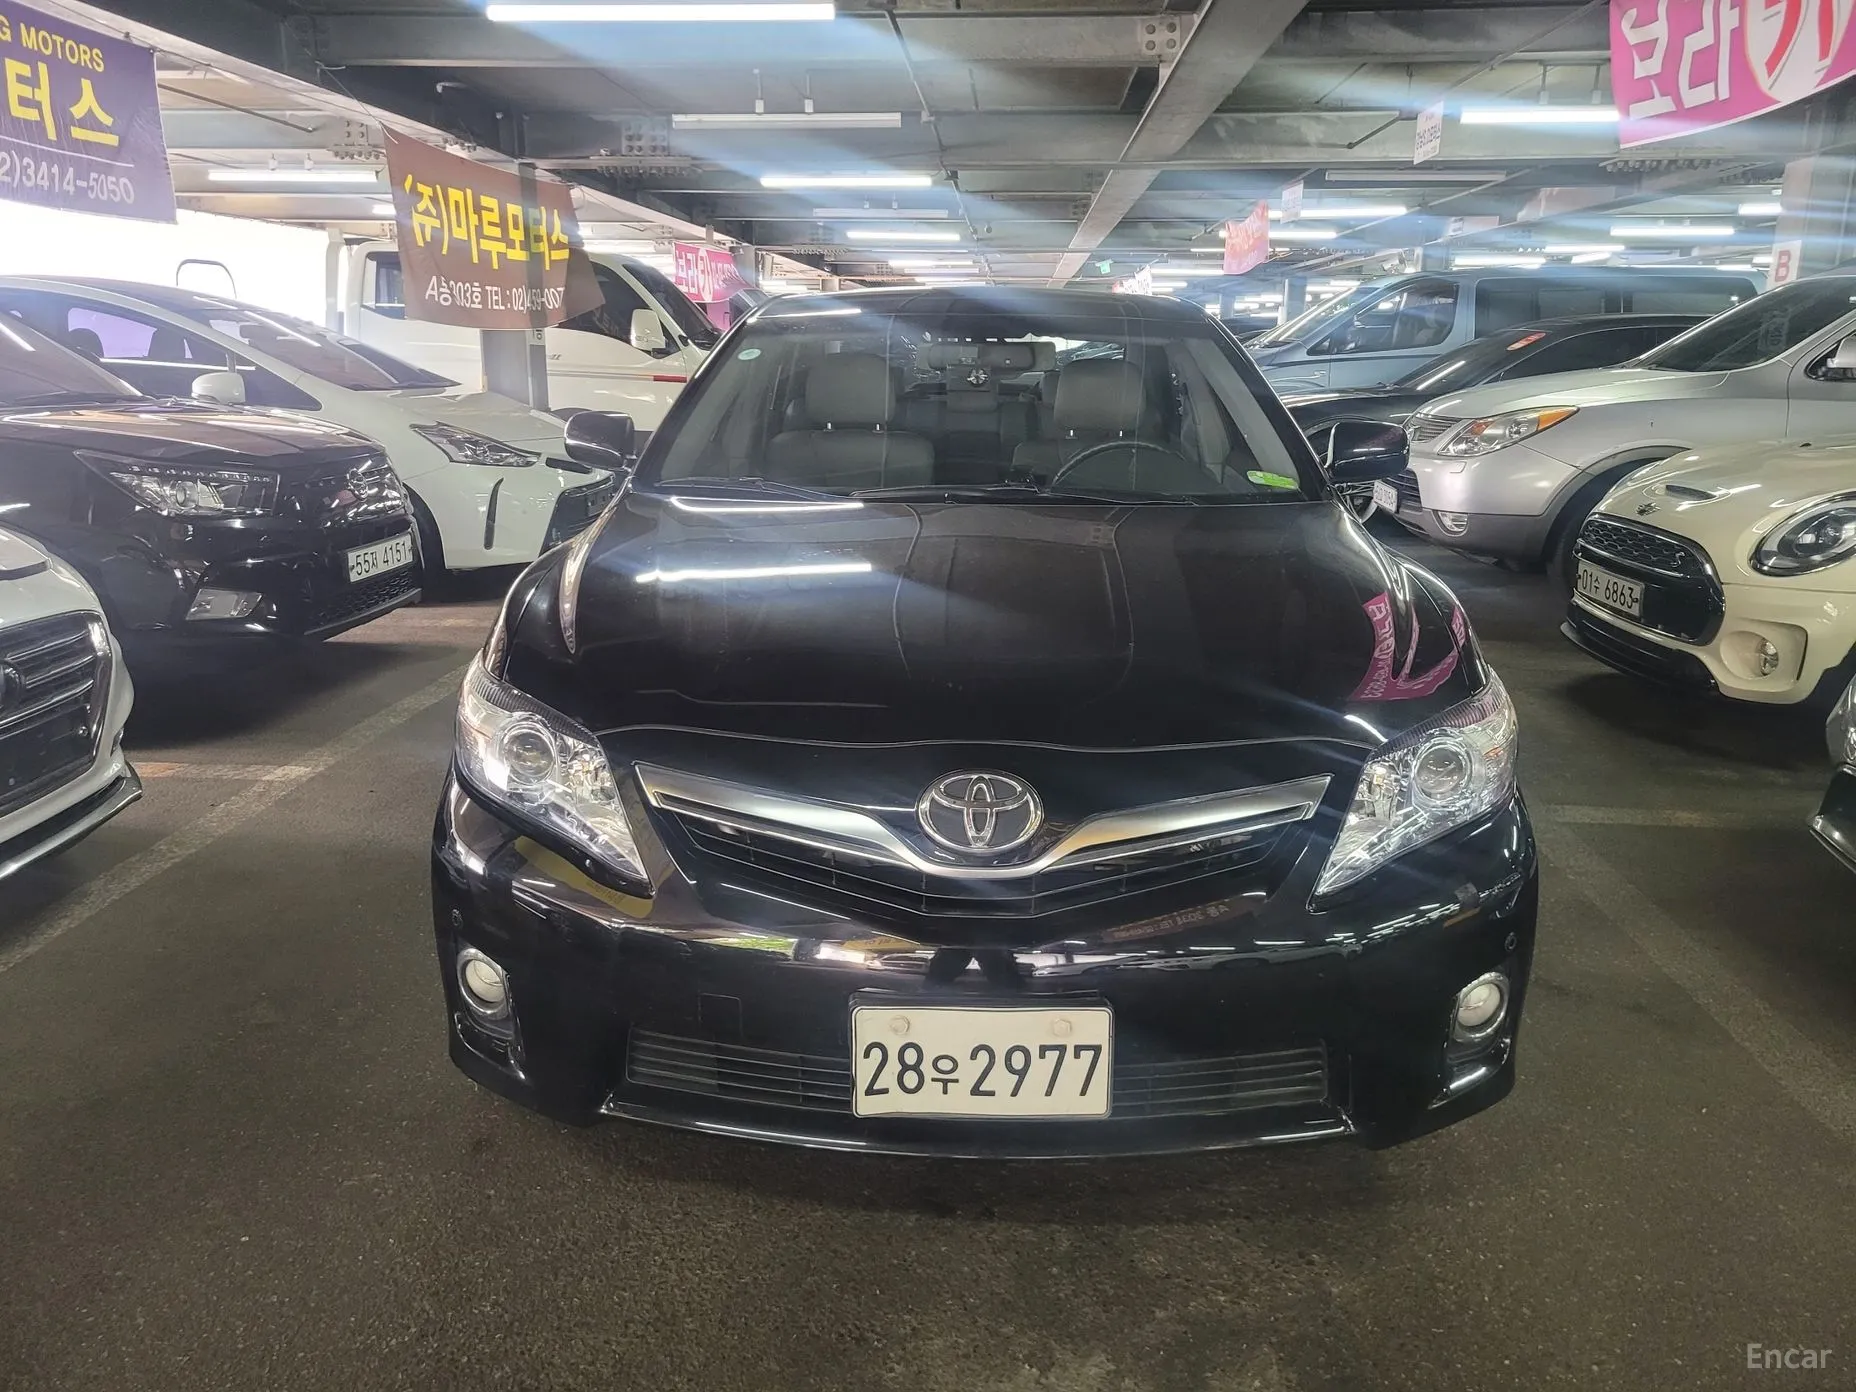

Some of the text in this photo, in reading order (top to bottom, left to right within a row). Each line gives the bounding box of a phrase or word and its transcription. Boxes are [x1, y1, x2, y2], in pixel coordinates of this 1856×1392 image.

[20, 22, 105, 72] MOTORS
[5, 57, 119, 147] 터스
[1774, 250, 1791, 282] B
[383, 541, 407, 566] 4151
[1582, 569, 1635, 609] 01수 6863
[863, 1041, 1103, 1097] 28우2977
